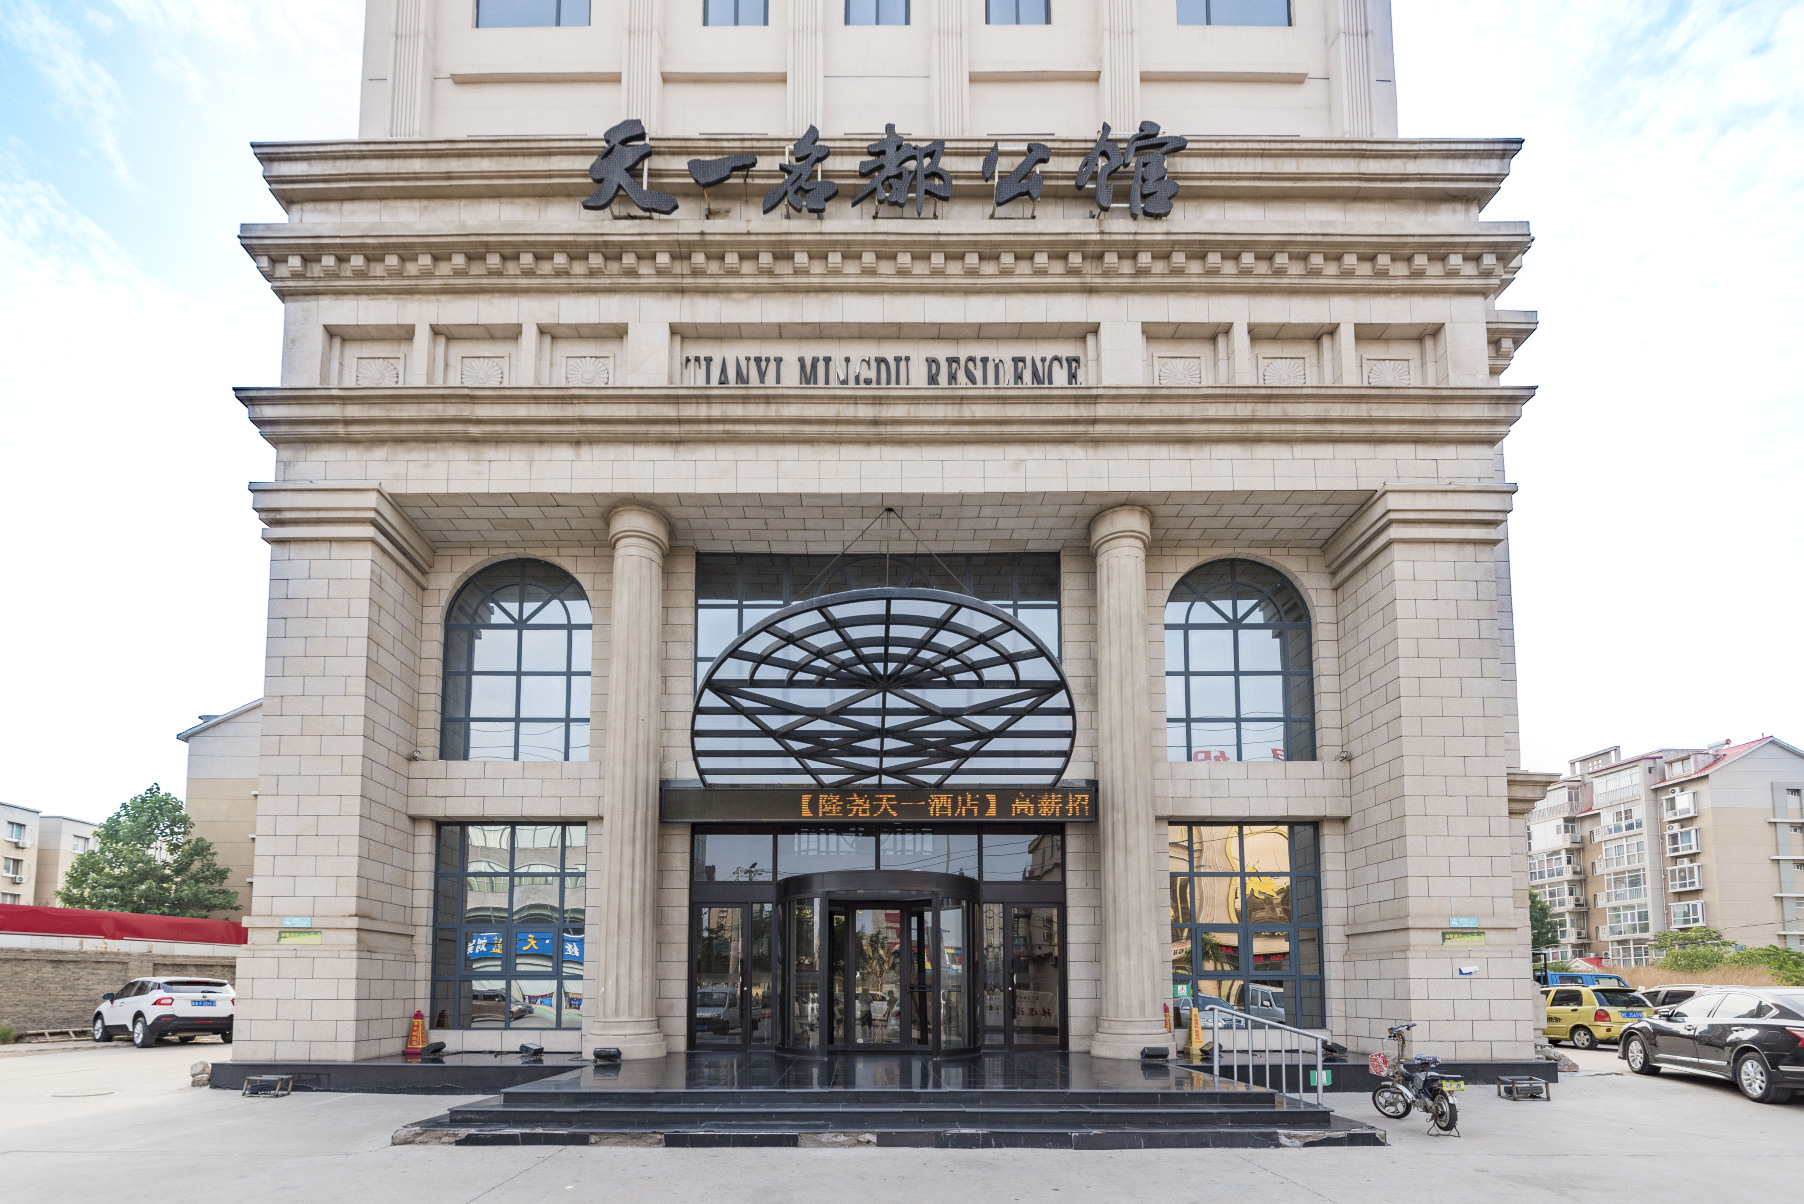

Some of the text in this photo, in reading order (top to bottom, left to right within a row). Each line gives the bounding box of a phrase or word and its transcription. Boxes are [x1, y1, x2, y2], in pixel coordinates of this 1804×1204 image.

[581, 118, 1188, 220] 天一名都公馆
[685, 355, 1082, 385] TIANYI MINGDU RESIDENCE
